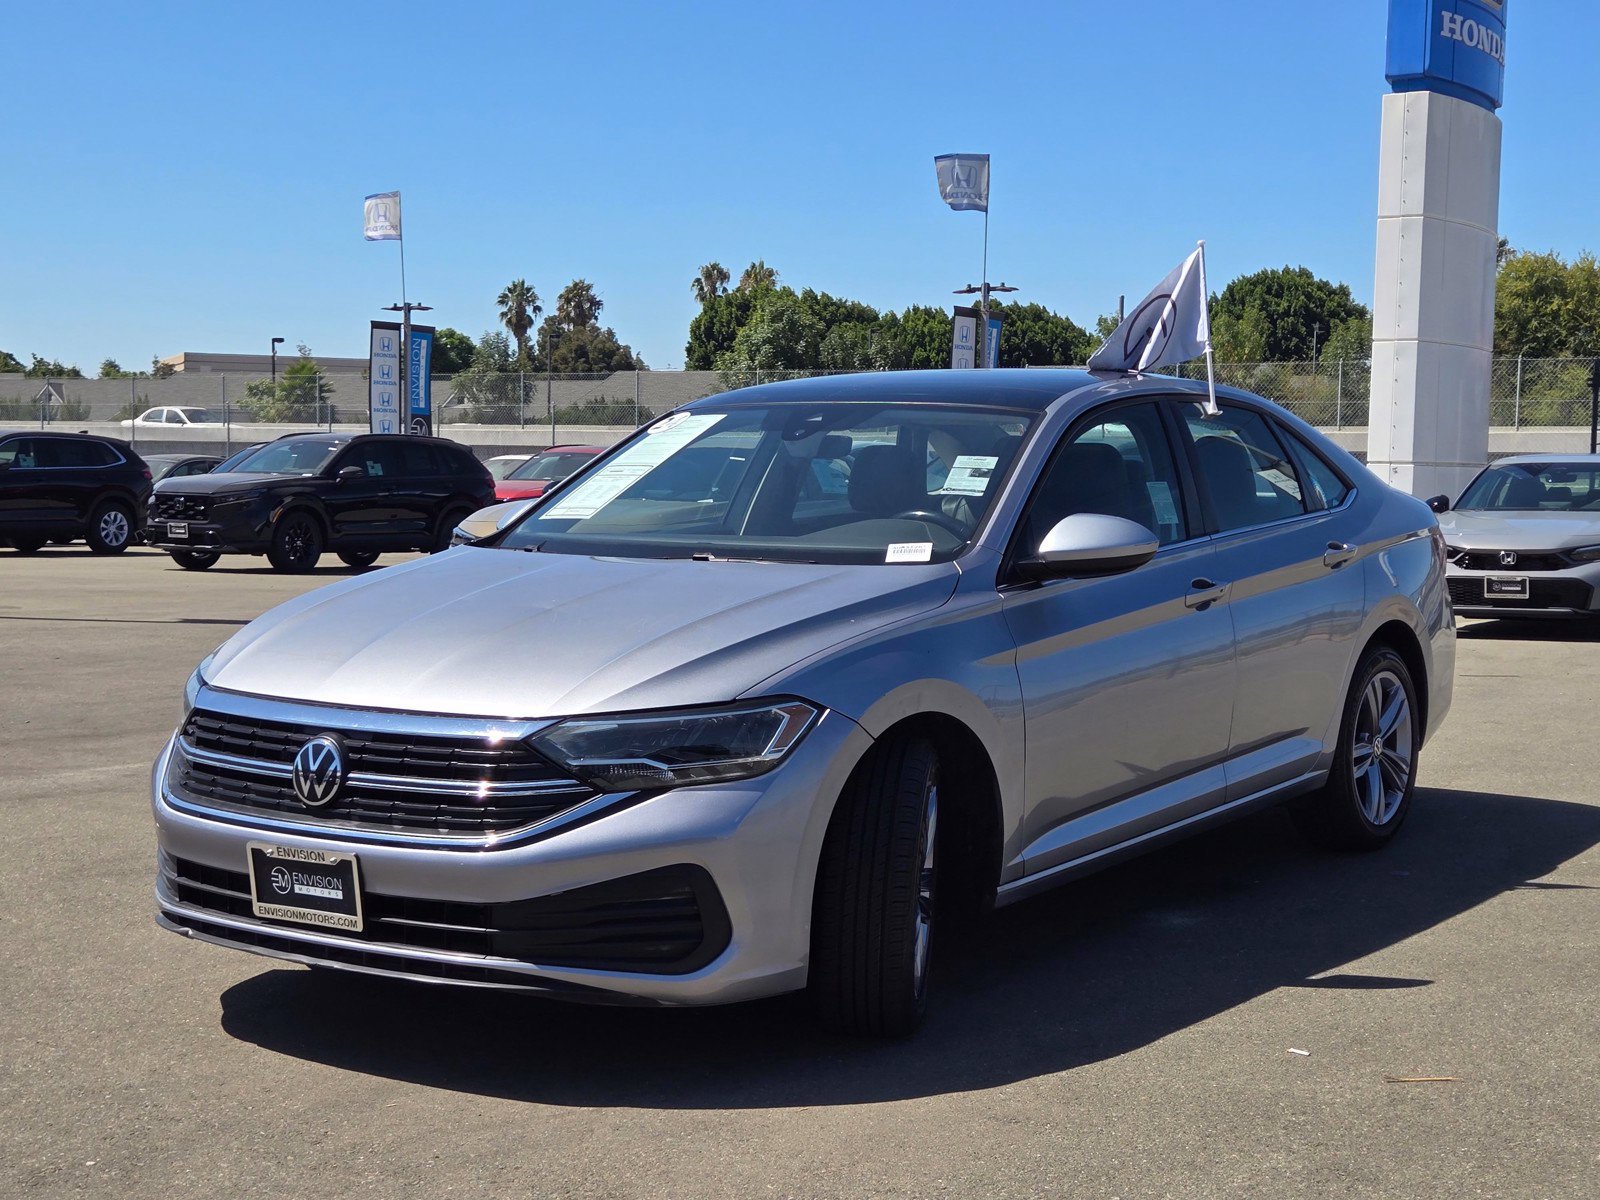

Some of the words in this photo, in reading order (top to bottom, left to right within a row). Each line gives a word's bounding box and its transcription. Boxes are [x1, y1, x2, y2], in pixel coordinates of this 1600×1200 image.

[412, 338, 421, 408] ENVISION
[276, 846, 325, 862] ENVISION
[292, 872, 343, 890] ENVISION
[298, 887, 339, 897] MOTORS
[258, 906, 358, 929] ENVISIONMOTORS.COM
